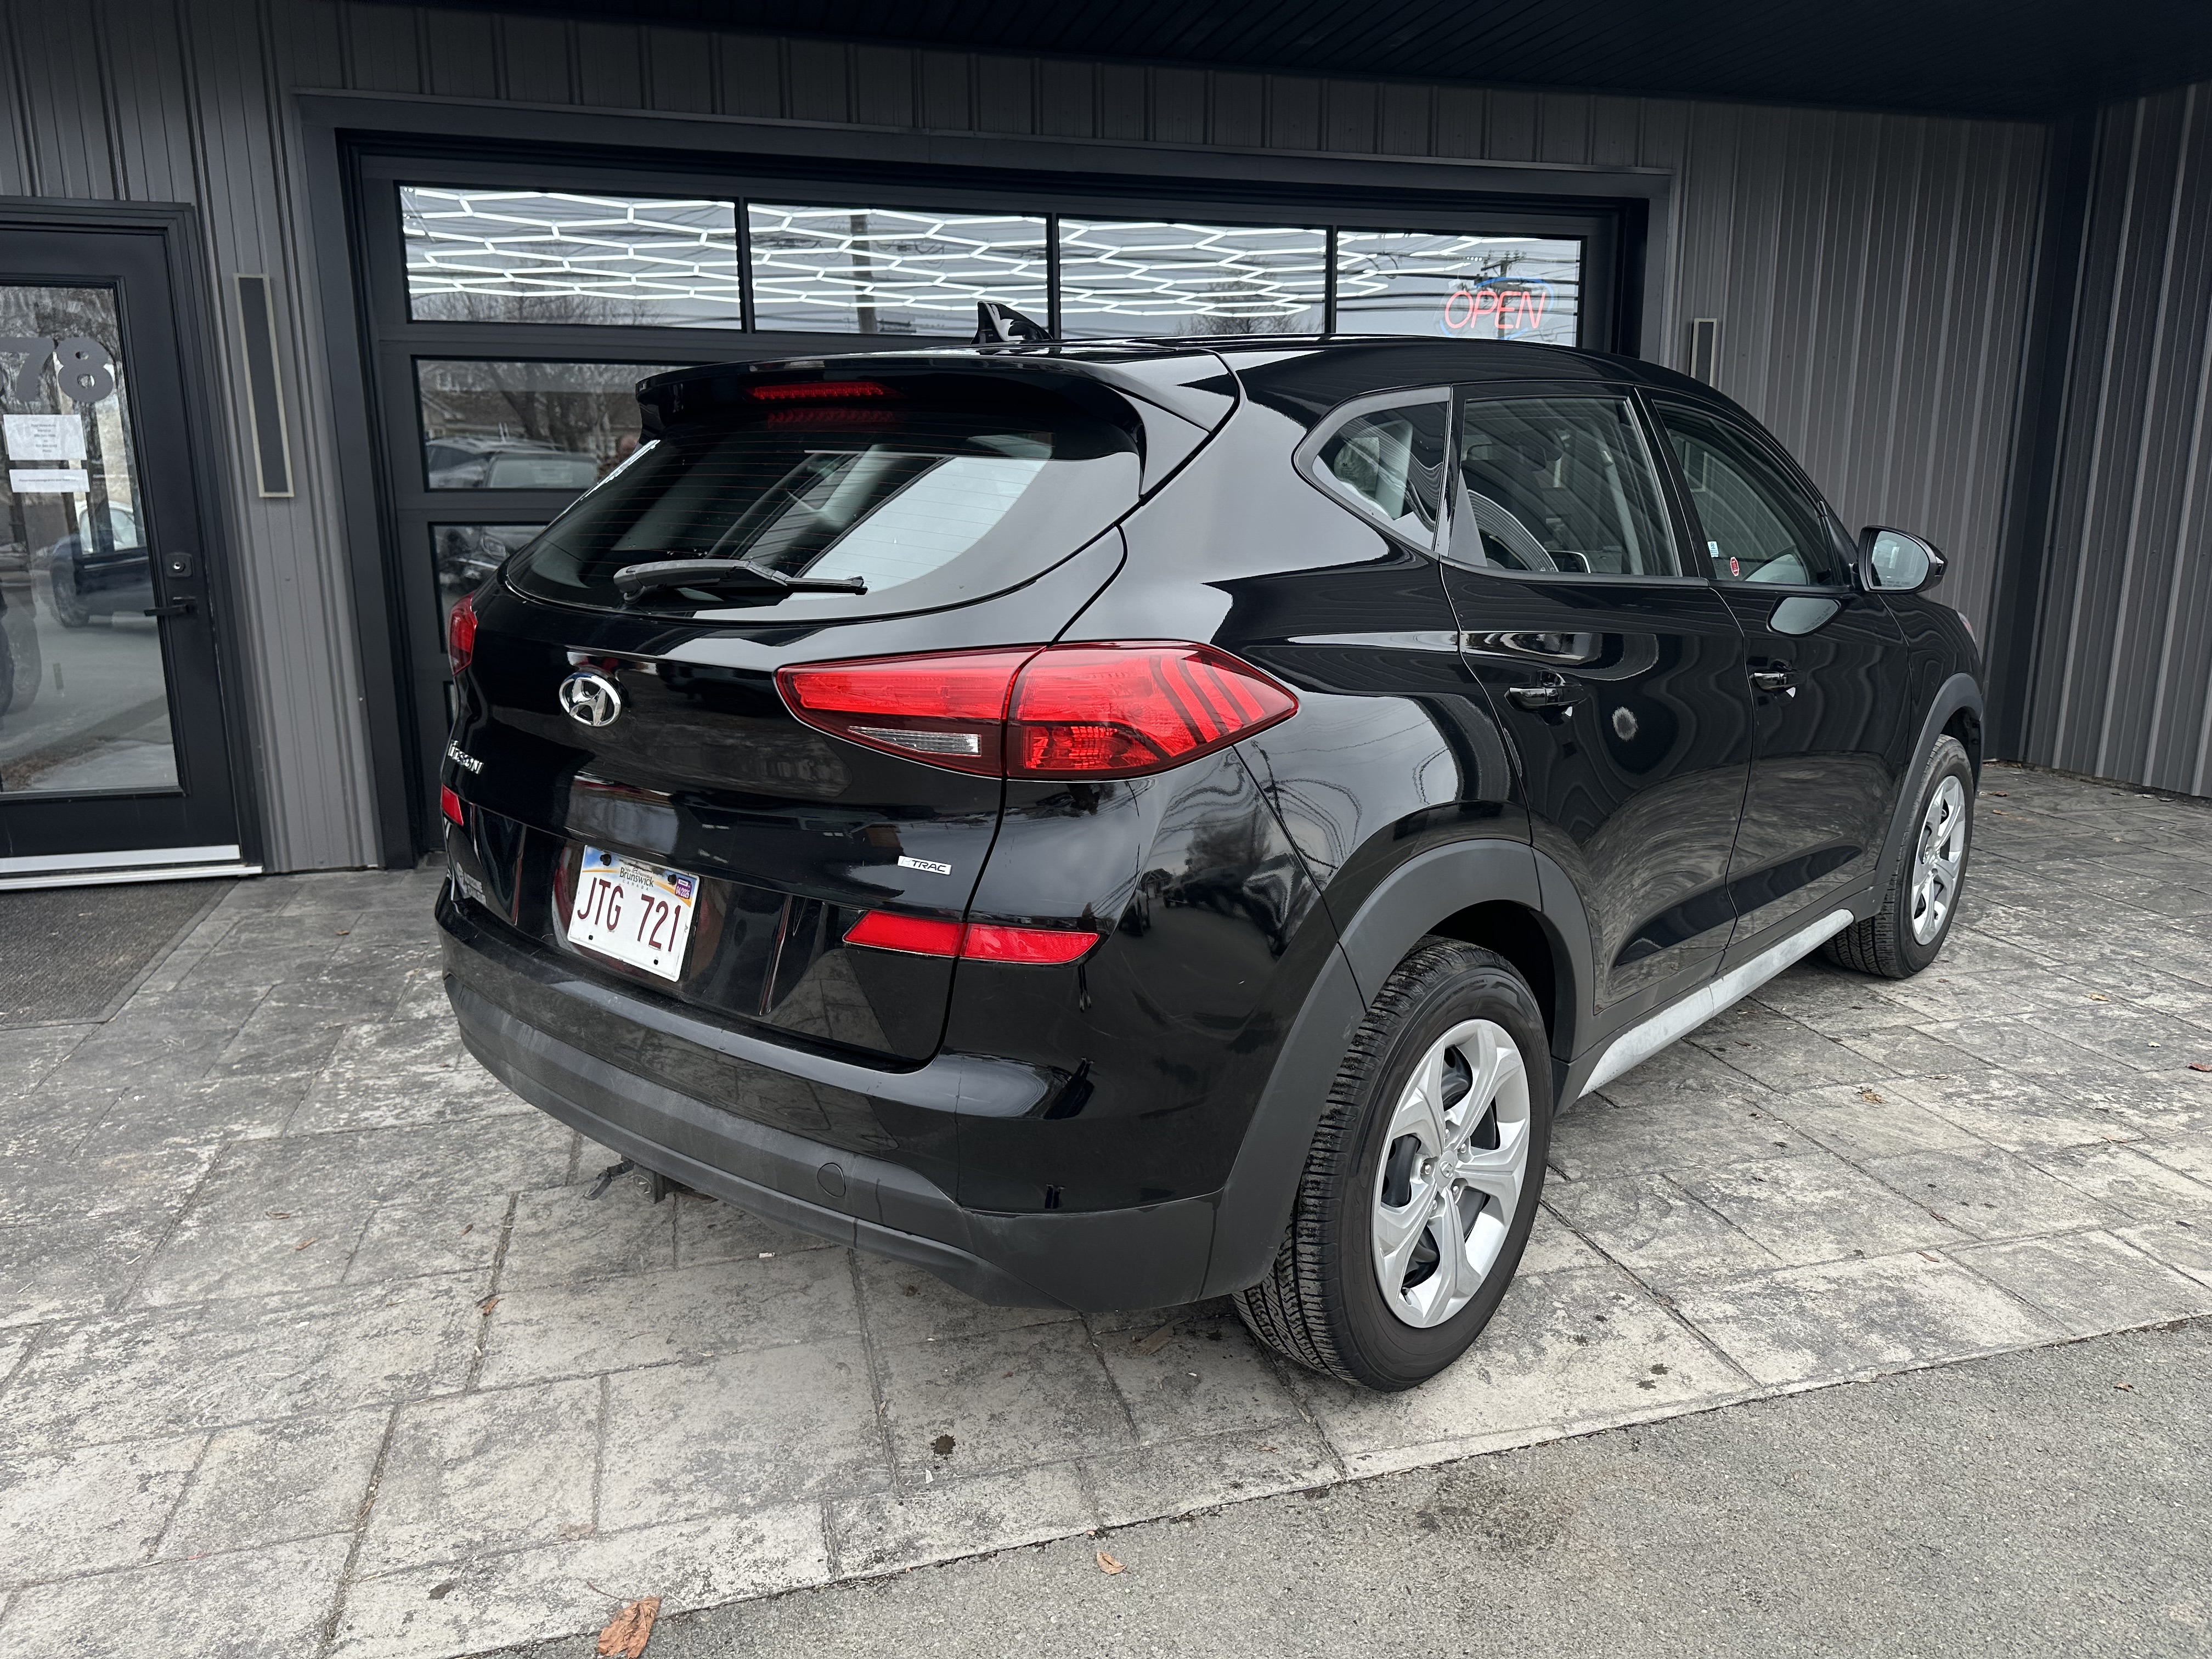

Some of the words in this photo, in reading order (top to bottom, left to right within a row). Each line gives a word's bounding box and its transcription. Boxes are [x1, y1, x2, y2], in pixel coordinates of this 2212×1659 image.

[1444, 291, 1546, 329] OPEN
[0, 337, 114, 403] 78
[619, 867, 654, 888] Brunswick
[623, 879, 648, 890] CANADA
[577, 877, 624, 931] JTG
[637, 894, 681, 952] 721
